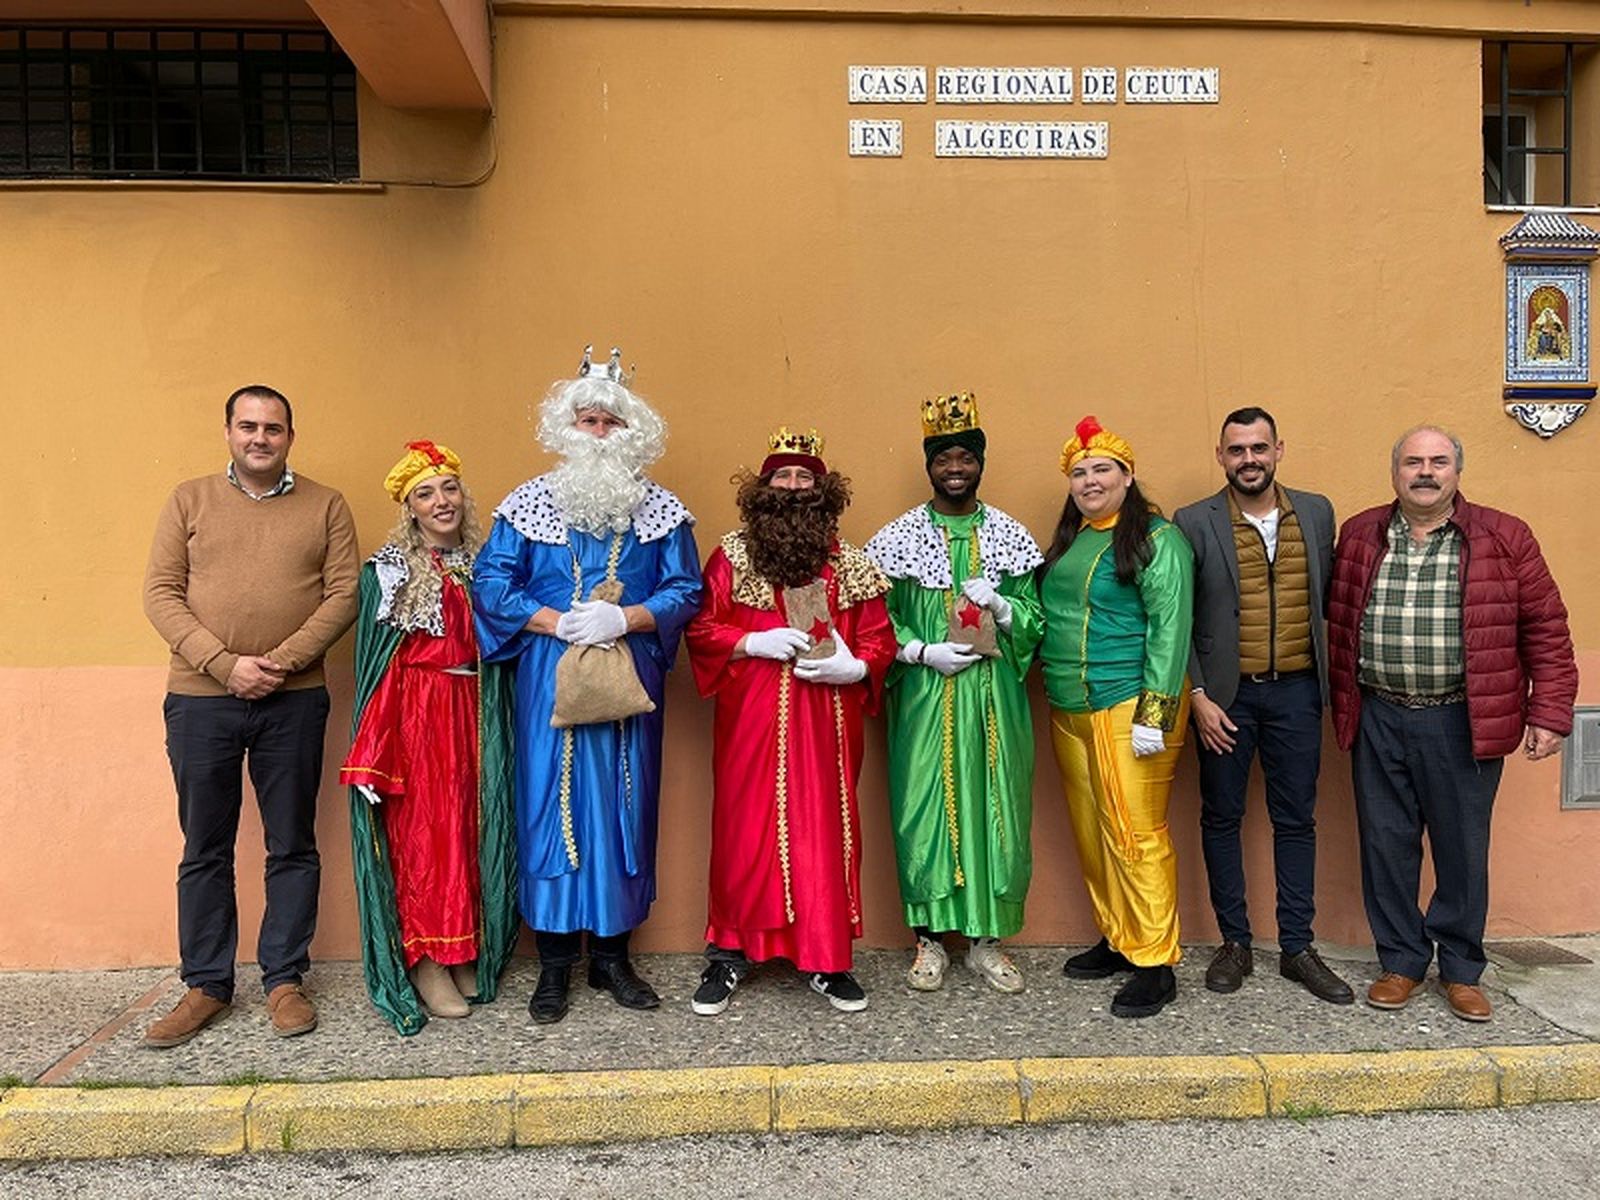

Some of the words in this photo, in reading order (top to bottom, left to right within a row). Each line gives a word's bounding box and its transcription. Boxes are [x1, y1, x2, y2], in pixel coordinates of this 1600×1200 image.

[859, 73, 926, 96] CASA
[937, 74, 1072, 96] REGIONAL
[1083, 74, 1116, 96] DE
[1127, 74, 1211, 96] CEUTA
[860, 126, 893, 148] EN
[944, 128, 1098, 150] ALGECIRAS
